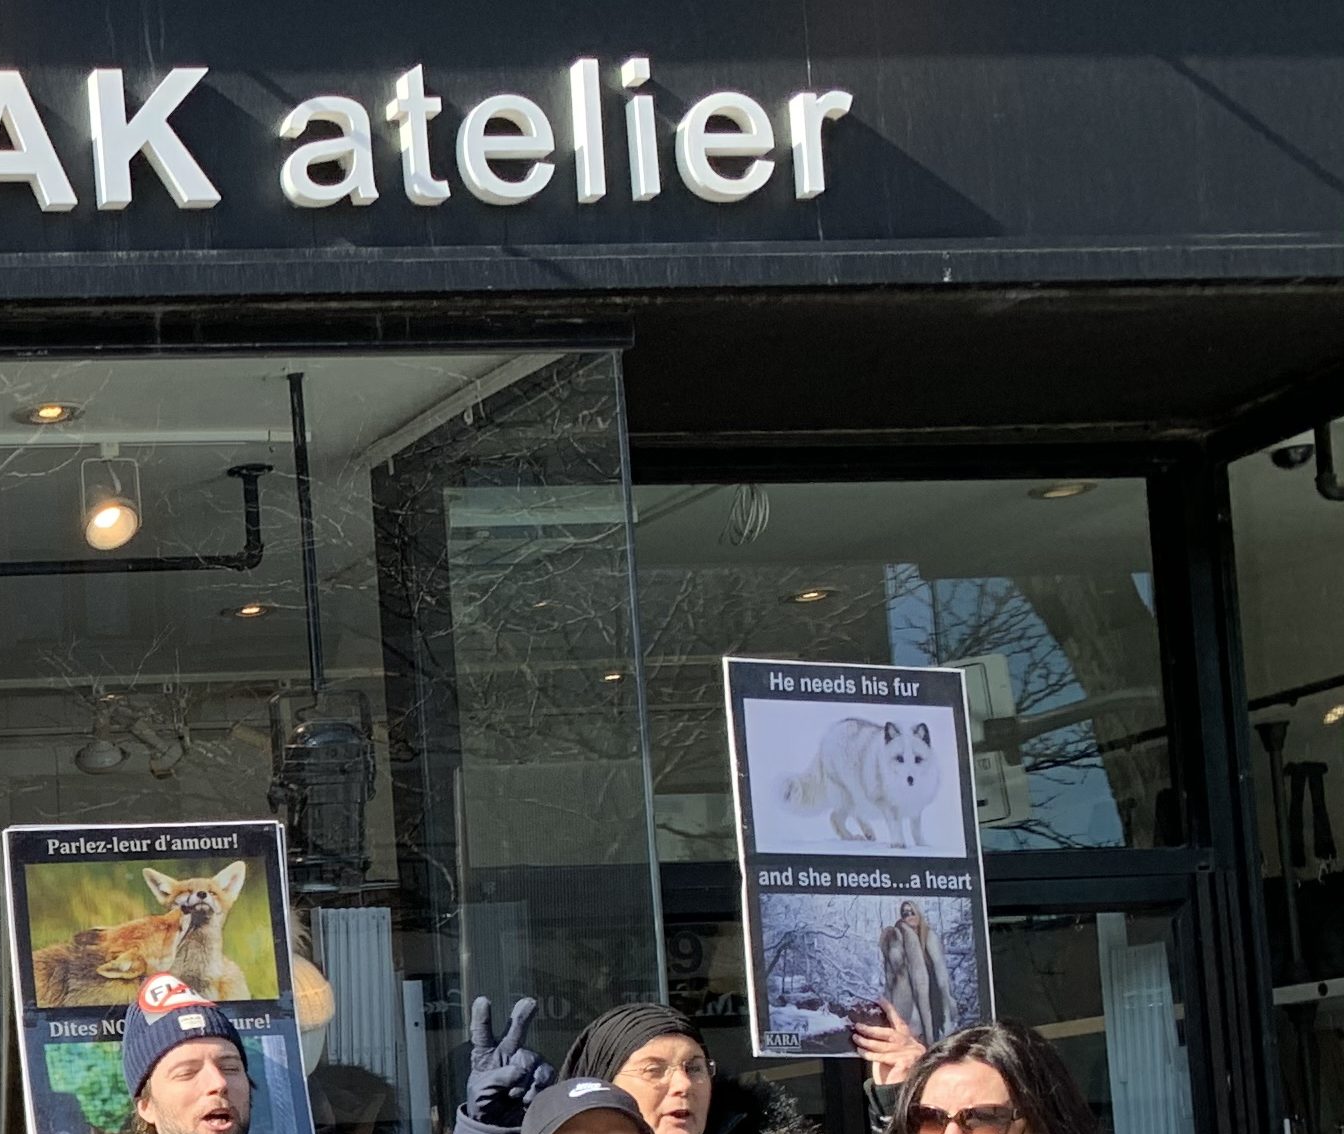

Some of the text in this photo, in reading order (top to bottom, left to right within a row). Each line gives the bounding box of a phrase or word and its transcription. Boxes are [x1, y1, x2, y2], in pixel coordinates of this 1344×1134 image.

[278, 57, 852, 206] atelier
[770, 672, 920, 697] He needs his fur
[47, 833, 239, 855] Parlez-leur d'amour!
[759, 868, 794, 886] and
[798, 868, 831, 886] she
[926, 871, 972, 890] heart
[49, 1018, 98, 1038] Dites
[766, 1034, 799, 1047] KARA
